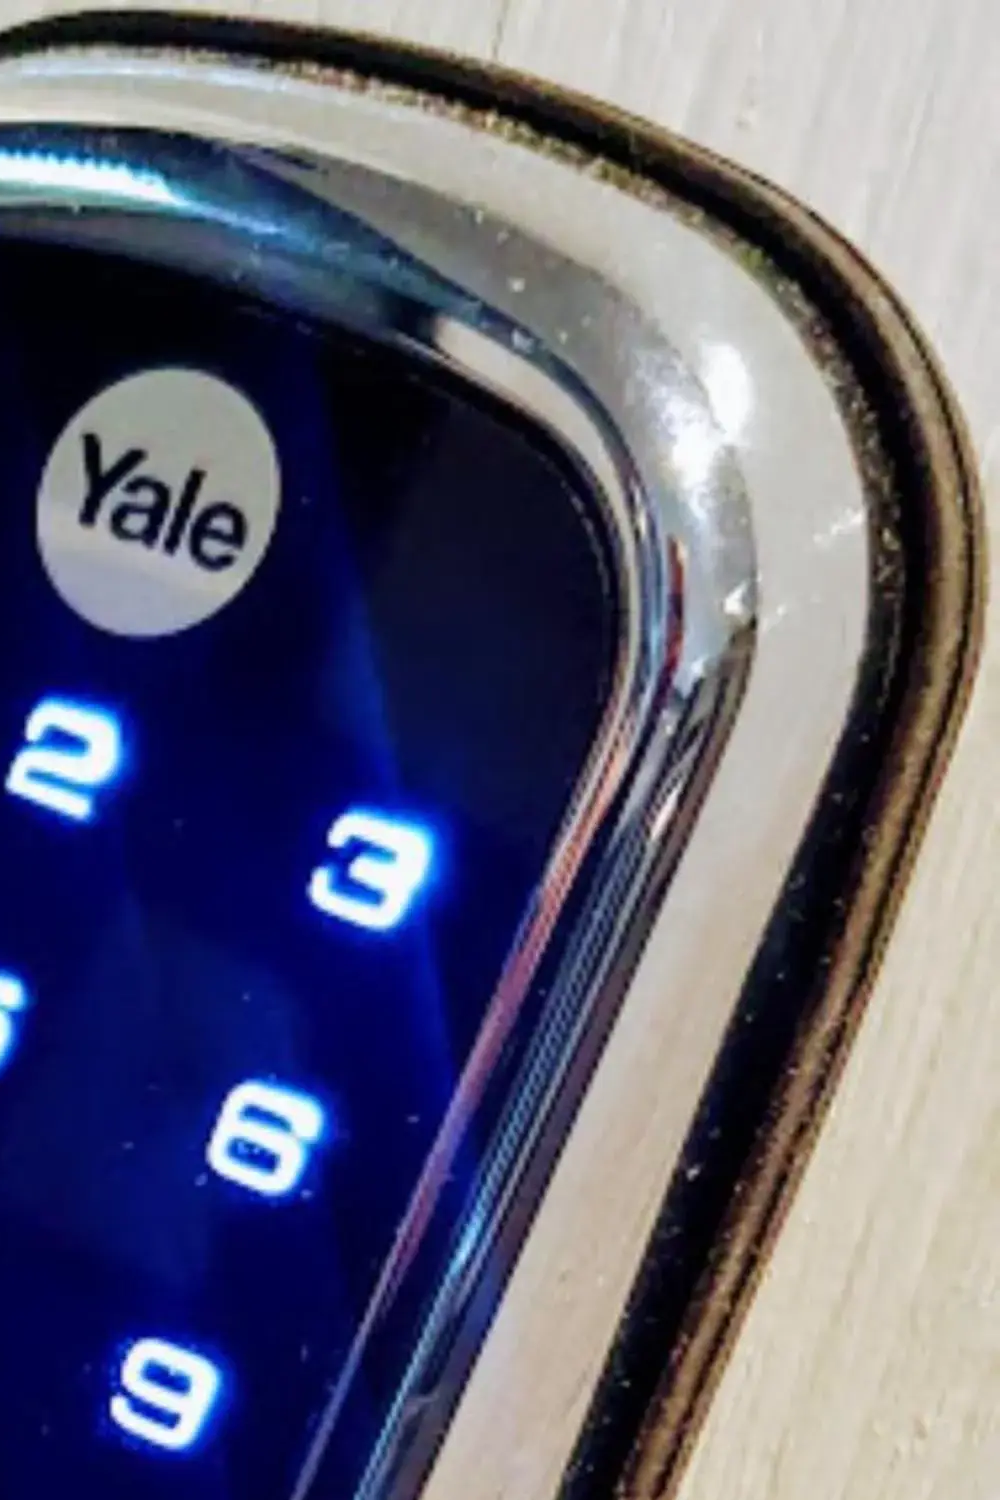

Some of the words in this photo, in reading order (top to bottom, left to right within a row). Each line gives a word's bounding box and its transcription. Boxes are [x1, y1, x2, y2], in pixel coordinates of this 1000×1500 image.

[77, 431, 249, 573] Yale
[6, 698, 125, 820] 2
[308, 809, 436, 932] 3
[207, 1080, 325, 1196] 6
[111, 1339, 222, 1449] 9
